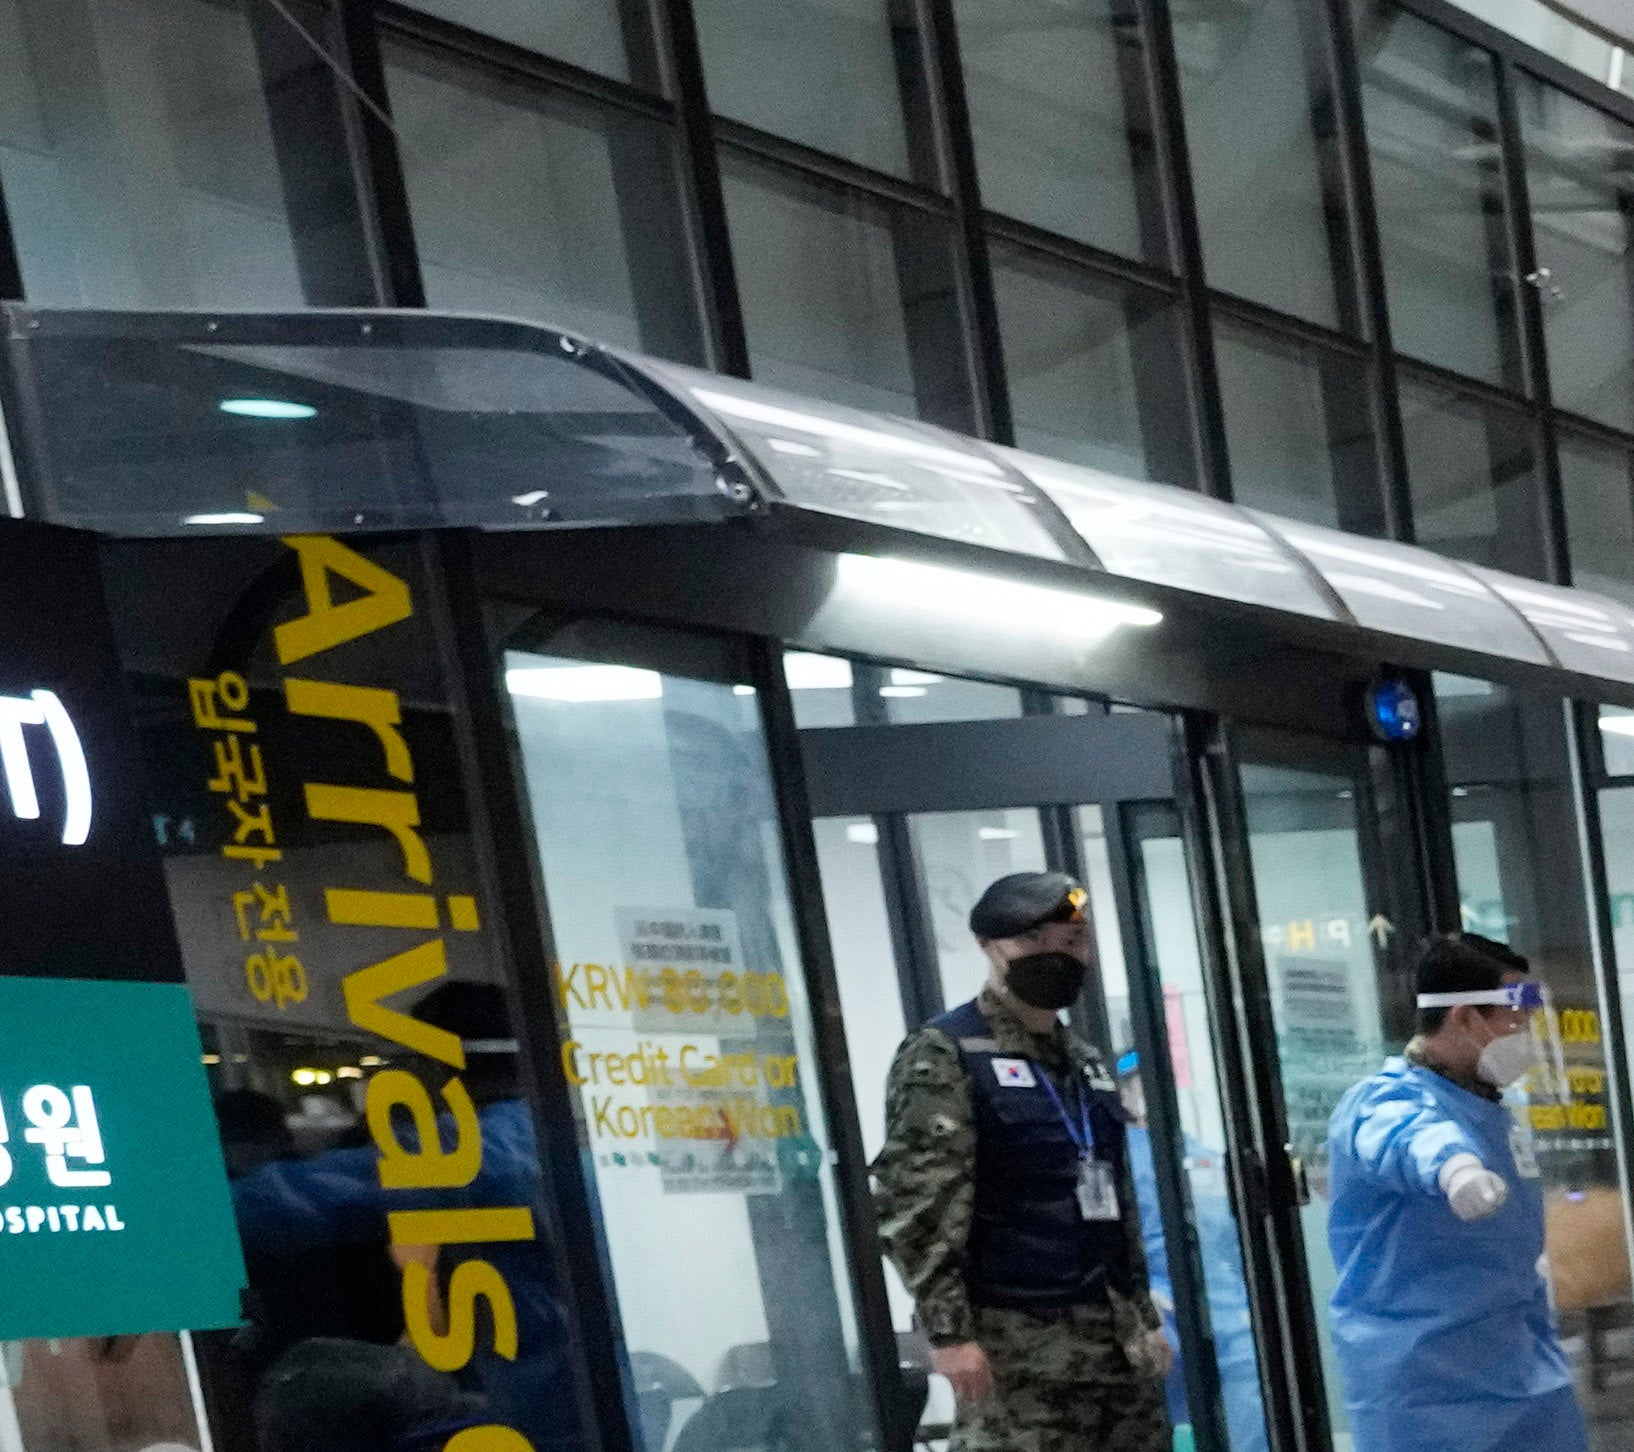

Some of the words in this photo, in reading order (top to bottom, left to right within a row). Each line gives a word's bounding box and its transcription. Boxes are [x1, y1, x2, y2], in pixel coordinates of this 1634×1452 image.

[187, 671, 284, 869] 입국자
[232, 880, 310, 1011] 전용
[262, 522, 537, 1373] Arrivals
[561, 1040, 675, 1088] Credit
